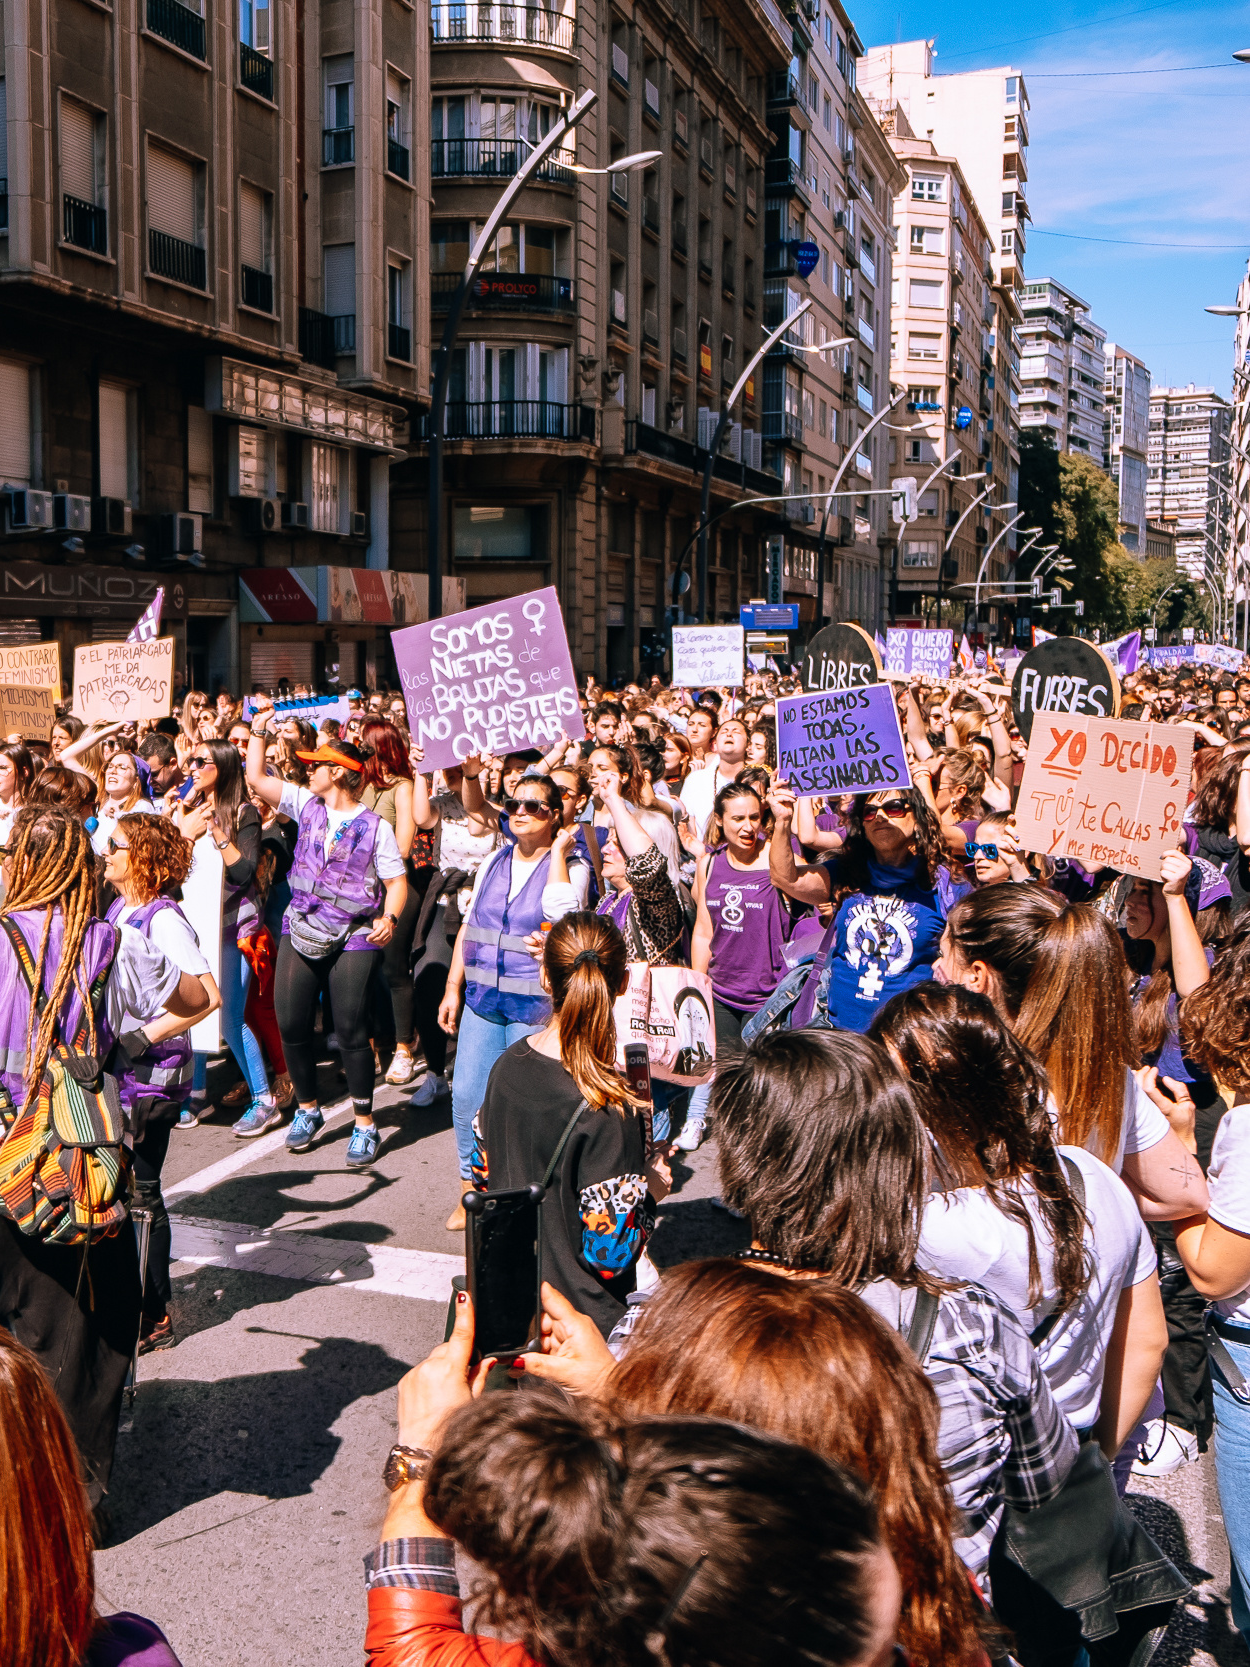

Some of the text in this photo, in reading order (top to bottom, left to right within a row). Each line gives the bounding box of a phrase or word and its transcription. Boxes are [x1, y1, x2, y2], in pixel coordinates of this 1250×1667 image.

[492, 282, 537, 294] PROLYCO
[4, 570, 158, 599] MUÑOZ
[430, 613, 513, 657] SOMOS
[889, 630, 952, 648] XQ QUIERO
[7, 648, 58, 669] CONTRARIO
[89, 642, 172, 663] EL PATRIARCADO
[104, 662, 139, 675] ME DA
[401, 639, 541, 691] las NIETAS de
[888, 647, 950, 661] XQ PUEDO
[78, 674, 168, 712] PATRIARCADAS
[407, 667, 561, 718] las BRUJAS que
[925, 677, 963, 690] UJERES
[418, 687, 578, 748] NO PUDISTEIS
[783, 689, 870, 724] NO ESTAMOS
[452, 717, 563, 760] QUEMAR
[780, 731, 880, 769] FALTAN LAS
[1044, 727, 1087, 767] YO
[789, 754, 899, 793] ASESINADAS
[1075, 793, 1097, 832] te
[1101, 801, 1151, 843] CALLAS
[1067, 837, 1084, 857] me
[631, 986, 649, 999] teng
[656, 1026, 675, 1036] Roll
